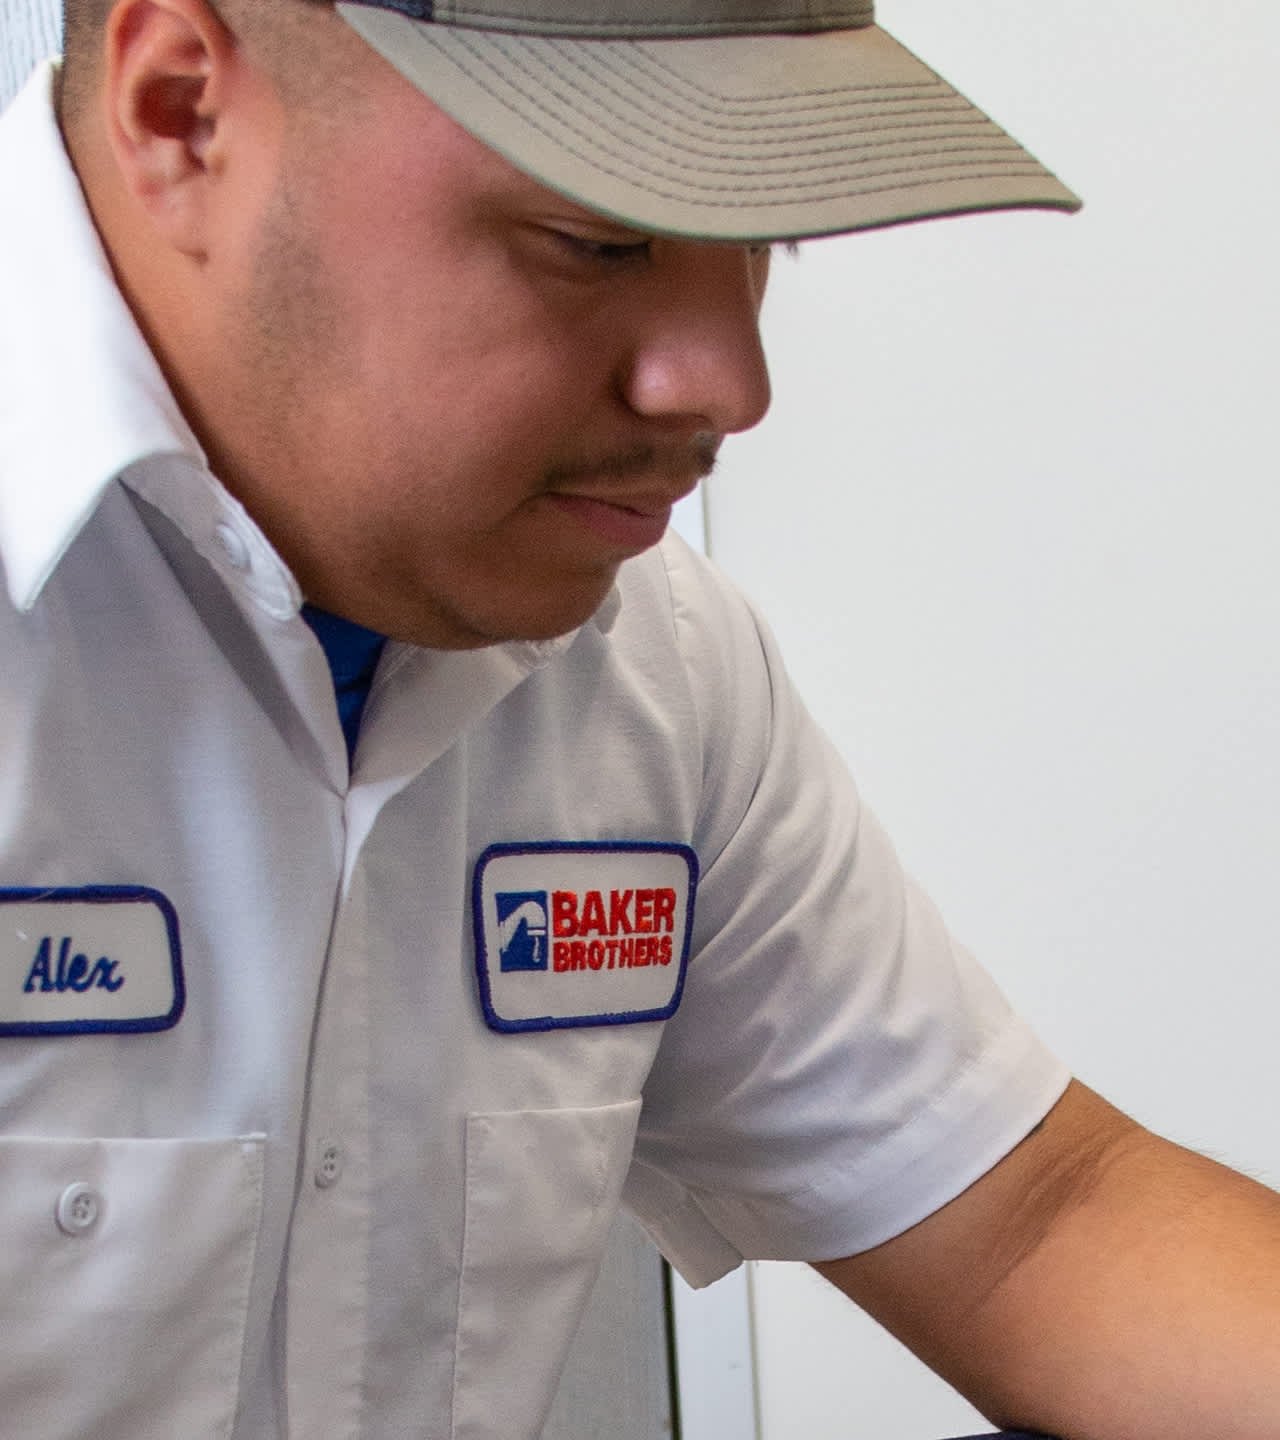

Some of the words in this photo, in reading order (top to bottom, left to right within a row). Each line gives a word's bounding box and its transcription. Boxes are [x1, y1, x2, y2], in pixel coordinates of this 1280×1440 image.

[551, 887, 677, 938] BAKER
[23, 936, 126, 993] Alex
[552, 935, 673, 973] BROTHERS
